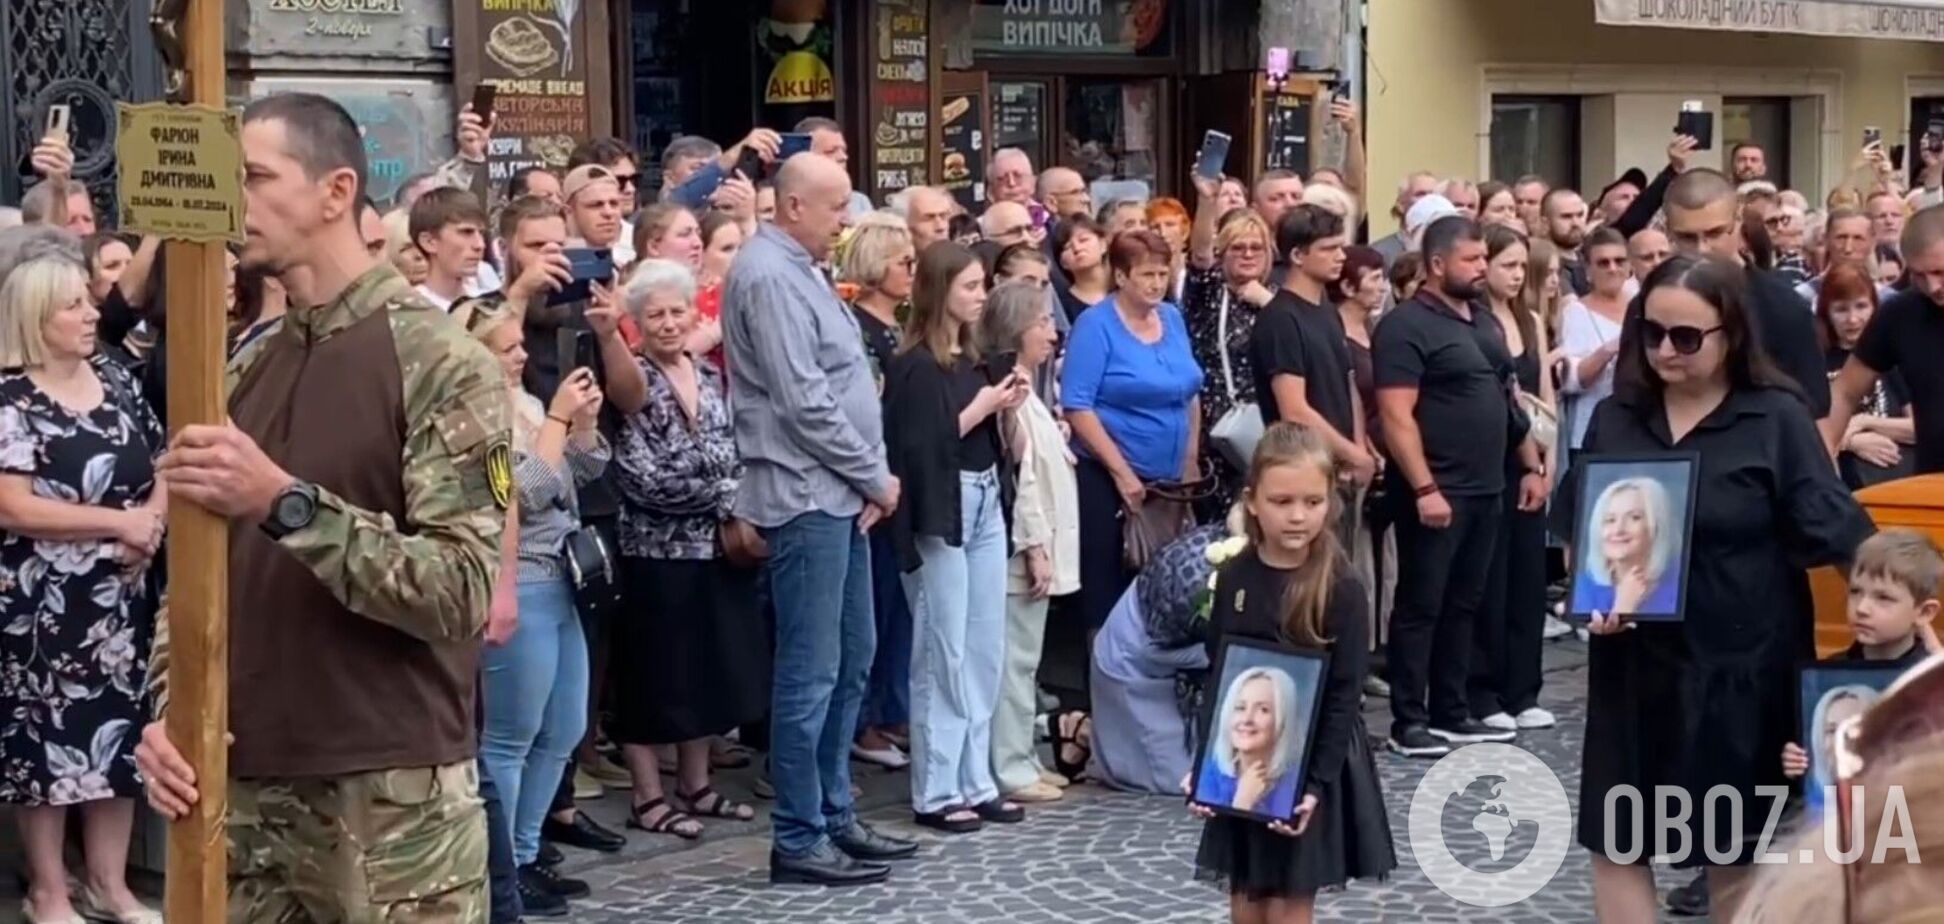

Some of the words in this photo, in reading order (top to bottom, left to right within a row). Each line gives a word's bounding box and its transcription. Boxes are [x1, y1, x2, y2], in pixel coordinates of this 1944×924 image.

[1003, 21, 1102, 48] ВИПІЧКА
[482, 79, 543, 95] MEMADE
[547, 80, 585, 95] BREAD
[769, 76, 832, 99] АКЦІЯ
[496, 113, 585, 133] КУЛІНАРІЯ
[150, 127, 200, 145] ФАРІОН
[487, 139, 522, 156] КУРИ
[158, 150, 196, 166] ІРИНА
[140, 170, 216, 190] ДМИТРІВНА
[488, 162, 508, 180] НА
